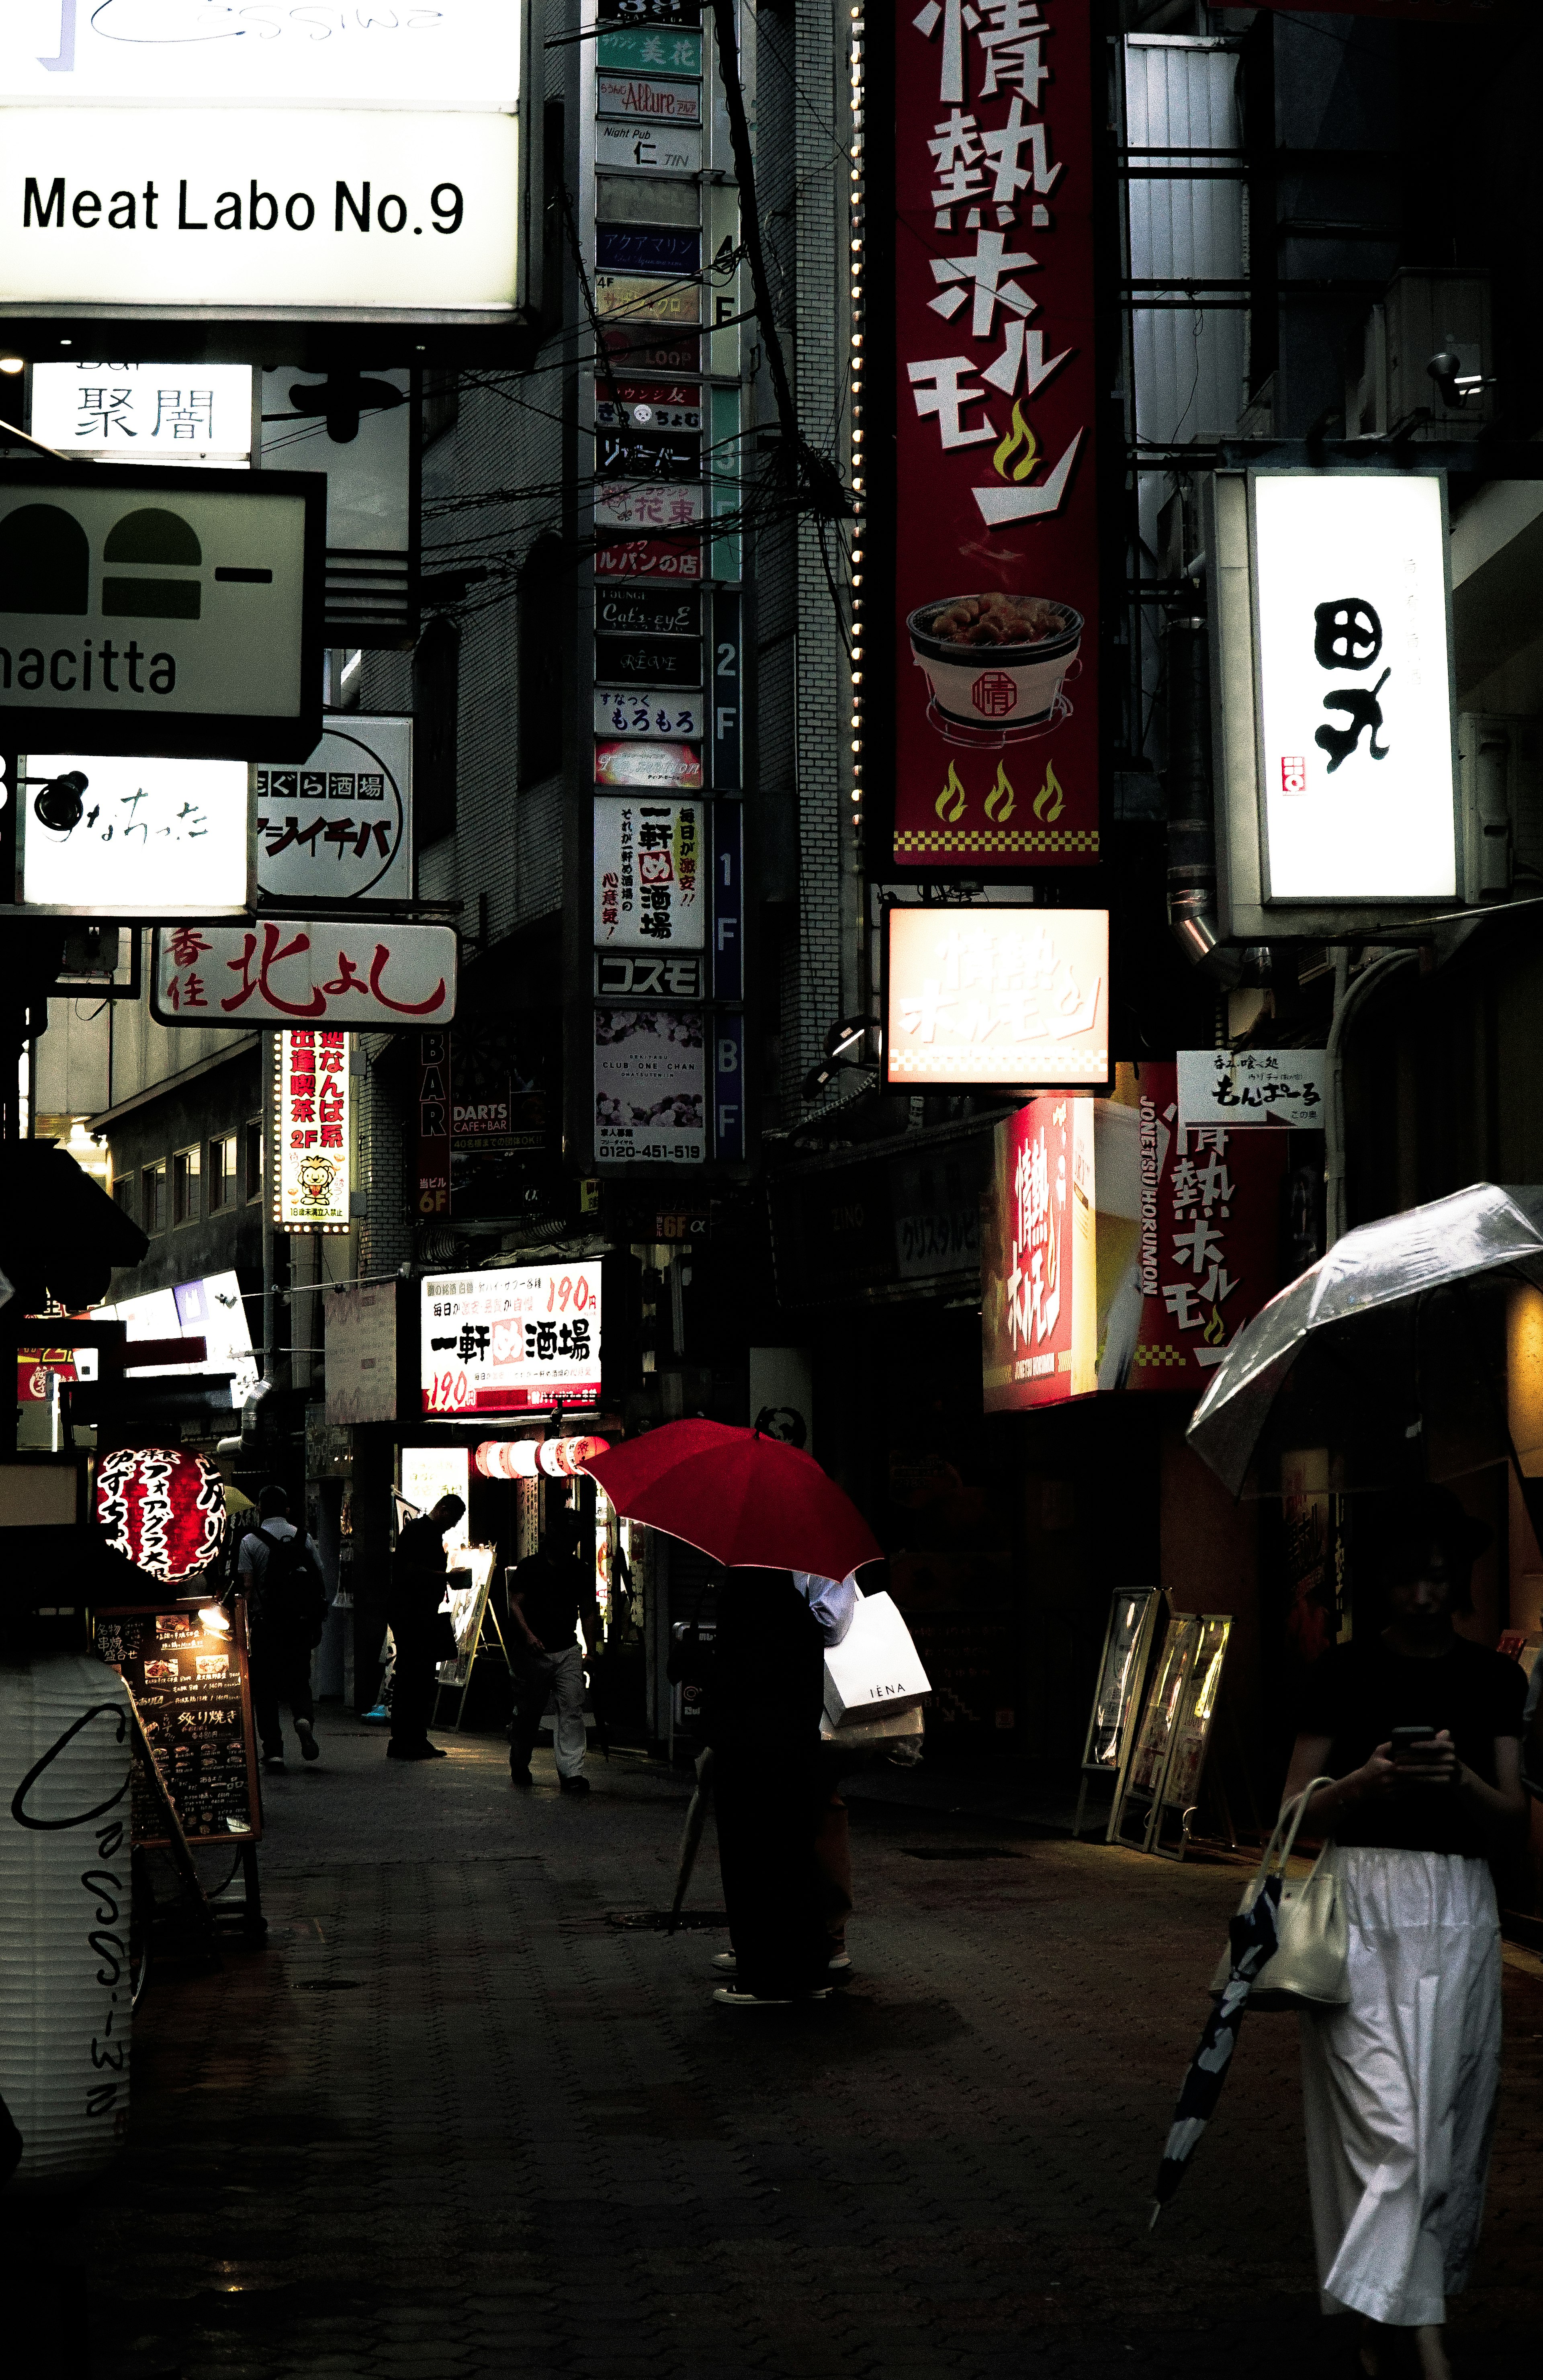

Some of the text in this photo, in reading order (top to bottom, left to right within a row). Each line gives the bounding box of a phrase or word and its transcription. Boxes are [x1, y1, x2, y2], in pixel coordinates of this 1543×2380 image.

[640, 35, 695, 67] 美花
[622, 82, 675, 114] Allure
[604, 127, 651, 140] Night Pub
[661, 154, 689, 166] JIN
[23, 177, 464, 235] Meat Labo No.9
[604, 233, 693, 254] アクアマリン
[906, 0, 1084, 526] 情熱ホルモン
[597, 277, 614, 288] 4F
[617, 387, 686, 403] ウンジ友
[634, 496, 695, 523] 花束
[600, 551, 698, 574] ルパンの店
[603, 590, 649, 600] LOUNGE
[600, 692, 651, 708] すなっく
[717, 643, 736, 739] 2F
[612, 708, 694, 733] もろもろ
[638, 807, 674, 939] 一軒め酒場
[718, 853, 737, 950] 1F
[221, 923, 446, 1017] 北よし
[602, 958, 696, 994] コスモ
[419, 1034, 447, 1137] BAR
[719, 1039, 738, 1137] BF
[453, 1103, 508, 1121] DARTS
[290, 1130, 317, 1149] 2F
[600, 1145, 700, 1159] 0120-451-519
[419, 1190, 446, 1213] 6F
[431, 1317, 591, 1365] 一軒め酒場
[178, 1710, 237, 1727] 炙り焼き
